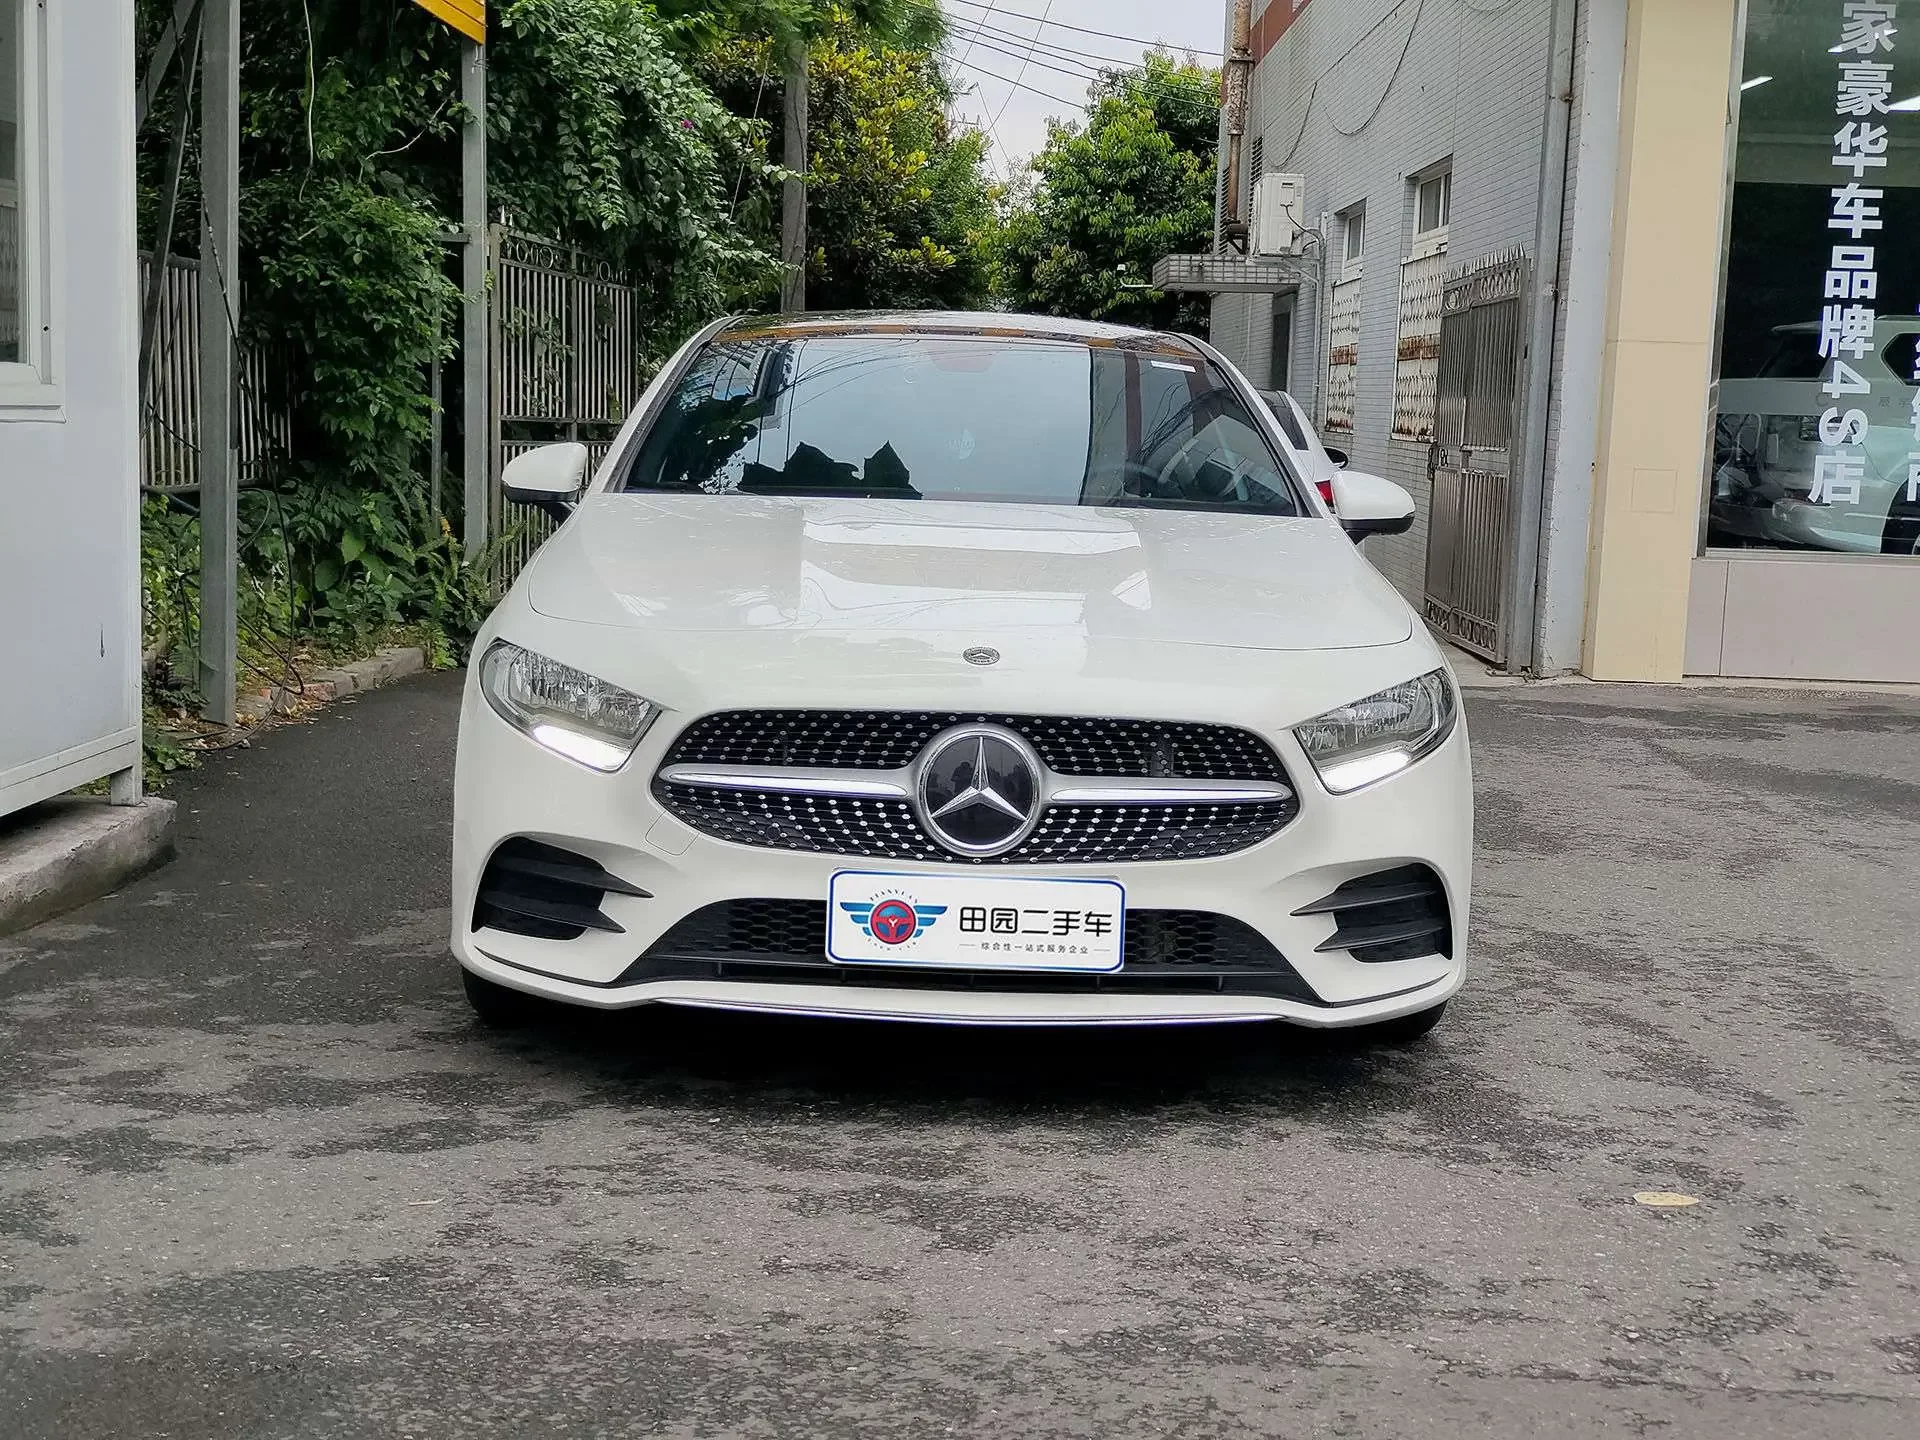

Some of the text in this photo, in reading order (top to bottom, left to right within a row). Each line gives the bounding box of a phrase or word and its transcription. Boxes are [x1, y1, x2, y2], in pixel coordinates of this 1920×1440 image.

[959, 906, 1113, 937] 田园二手车
[981, 941, 1089, 955] 综合性一站式服务企业
